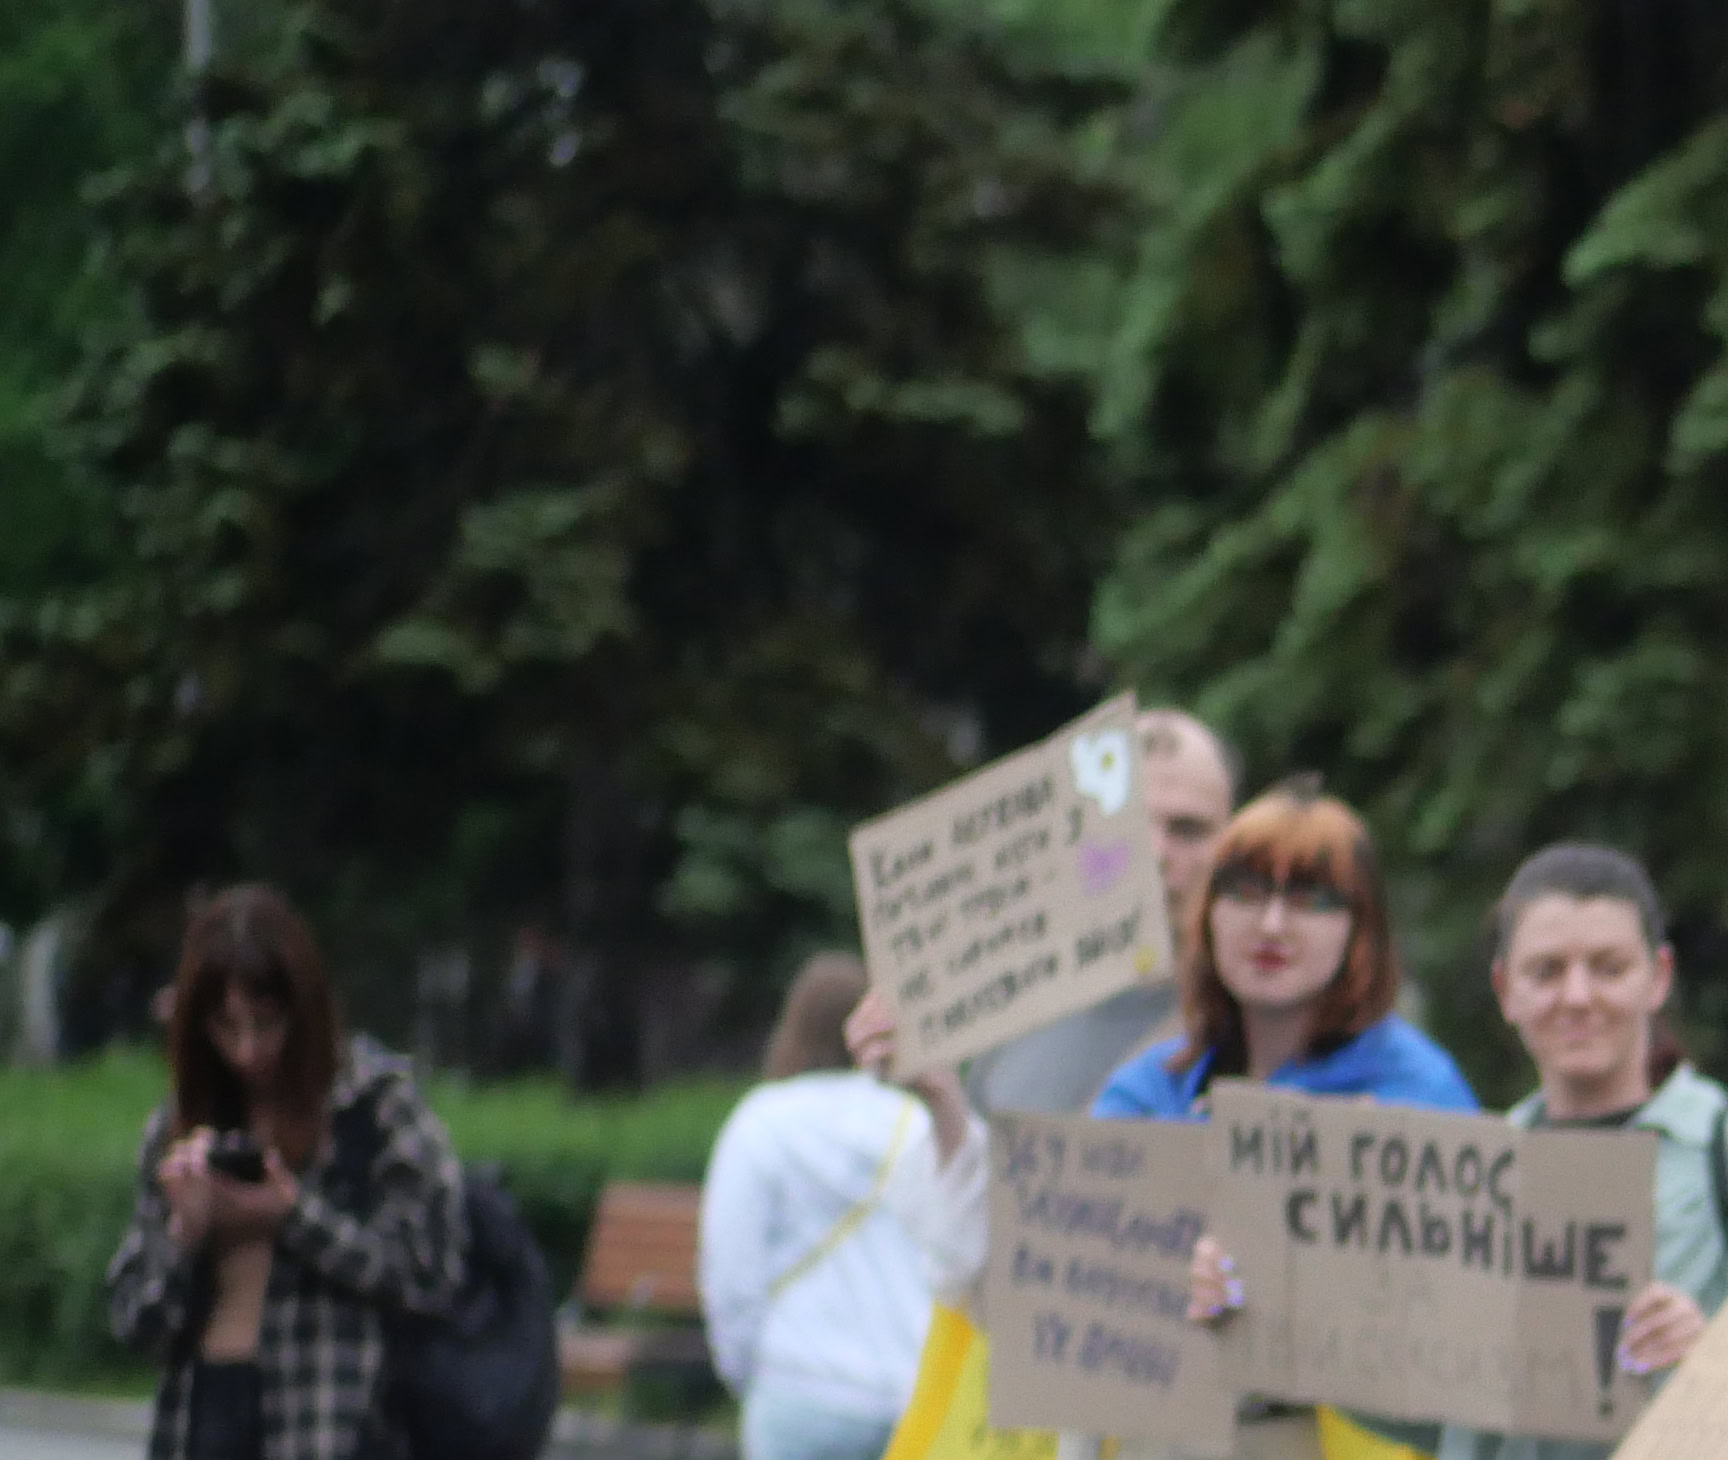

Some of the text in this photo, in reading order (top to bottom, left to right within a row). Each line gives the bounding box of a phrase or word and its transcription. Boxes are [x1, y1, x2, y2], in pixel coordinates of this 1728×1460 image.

[1229, 1106, 1318, 1175] МІЙ
[1350, 1131, 1516, 1202] ГОЛОС
[1283, 1188, 1629, 1290] СИЛЬНІШЕ
